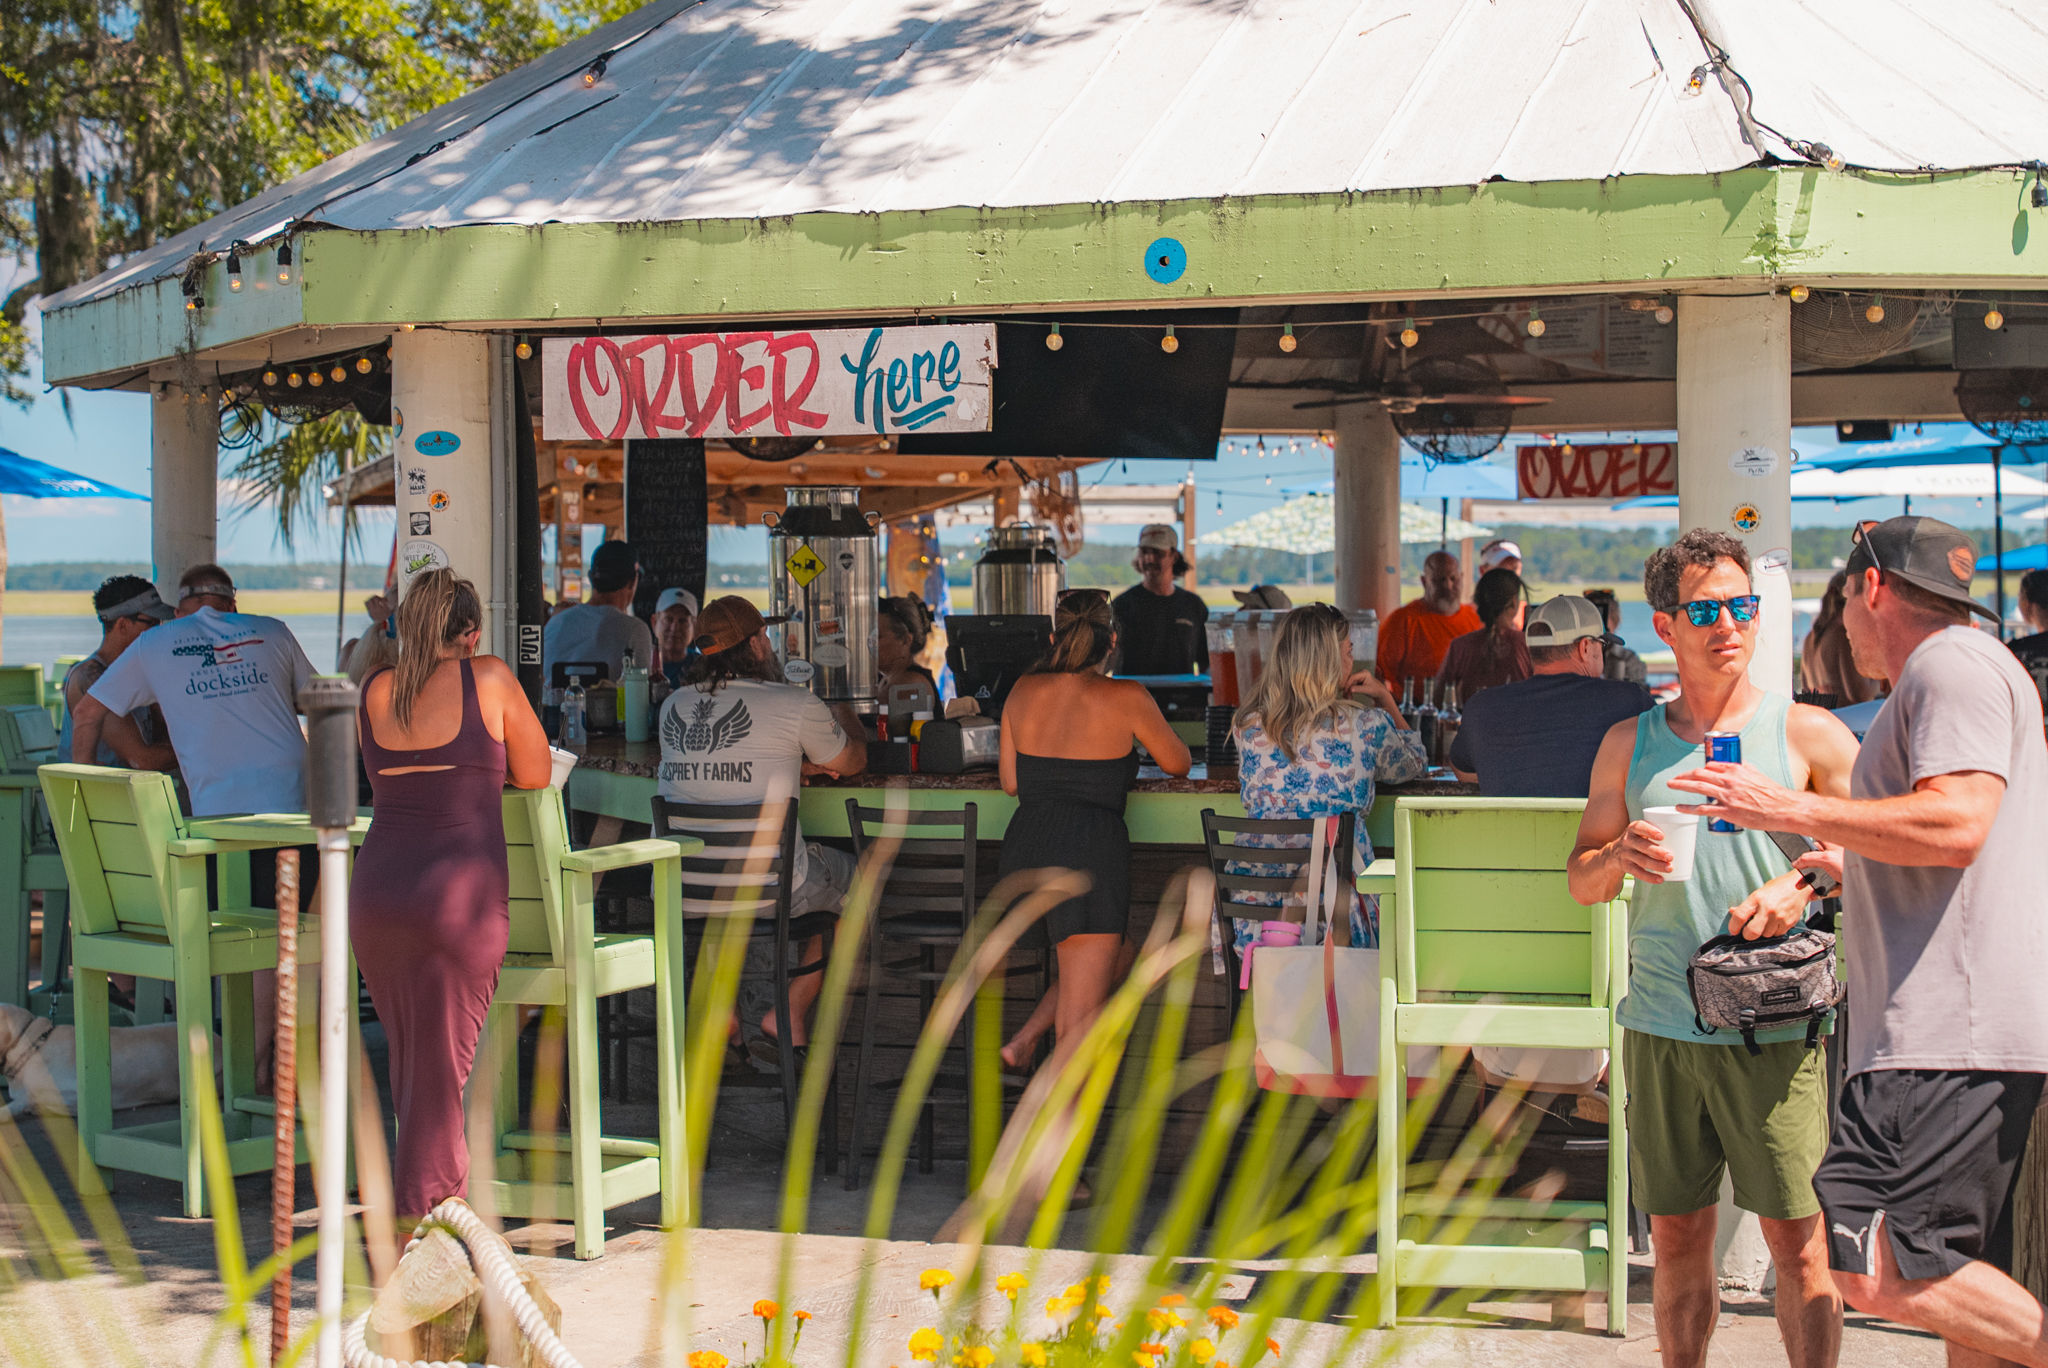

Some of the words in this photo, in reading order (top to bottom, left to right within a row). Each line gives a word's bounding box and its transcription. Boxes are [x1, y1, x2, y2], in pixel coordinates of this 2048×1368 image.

[566, 331, 829, 439] ORDER
[840, 327, 961, 435] here
[1518, 443, 1675, 498] ORDER
[521, 627, 539, 661] PULP
[185, 668, 269, 695] dockside
[703, 761, 752, 783] FARMS
